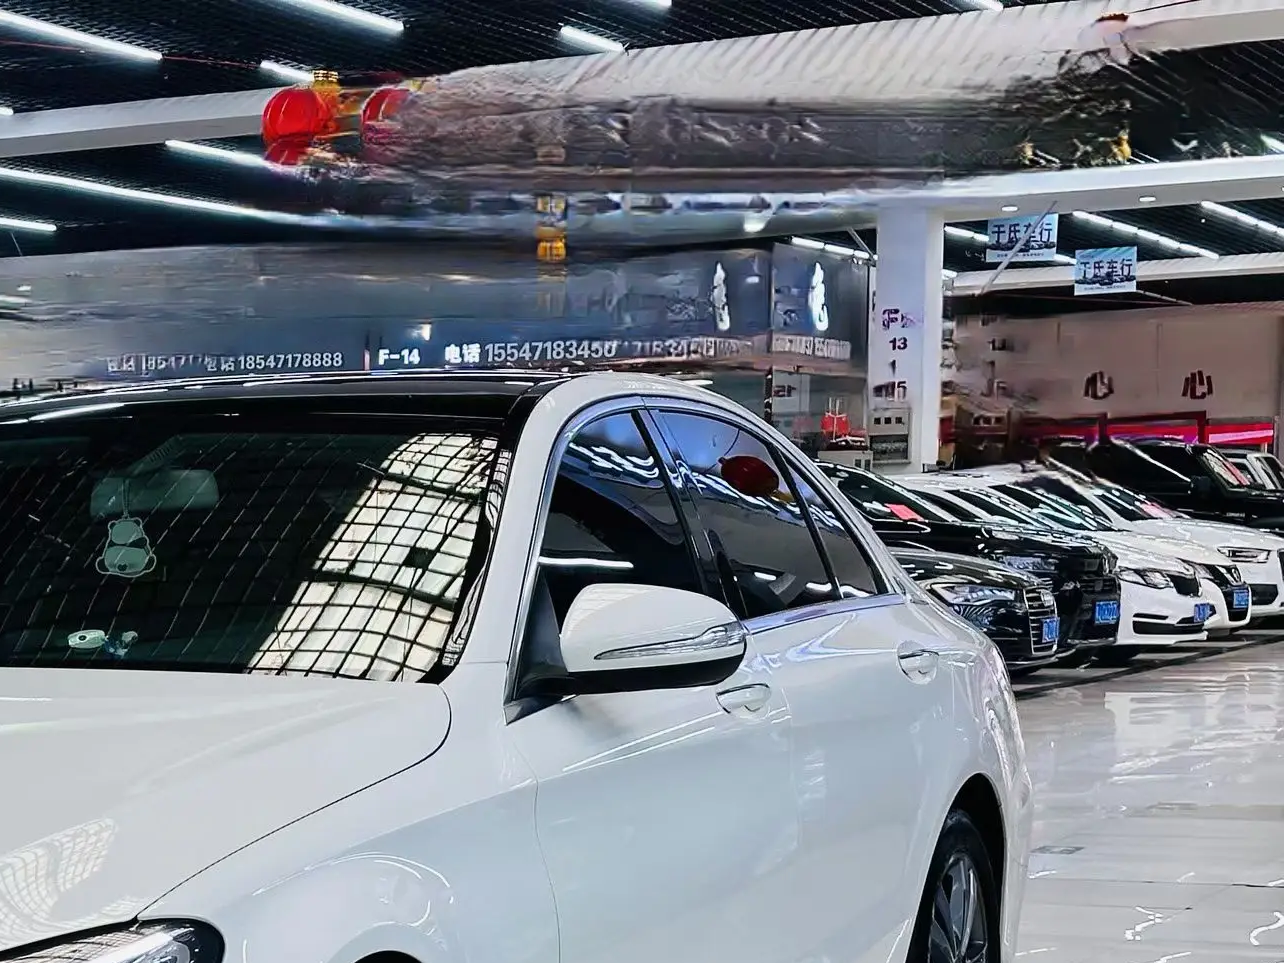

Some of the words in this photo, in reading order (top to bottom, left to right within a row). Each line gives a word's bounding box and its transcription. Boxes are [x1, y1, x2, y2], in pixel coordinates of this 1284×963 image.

[889, 336, 908, 350] 13
[238, 352, 343, 369] 18547178888
[378, 348, 421, 365] F-14
[444, 343, 480, 363] 电话
